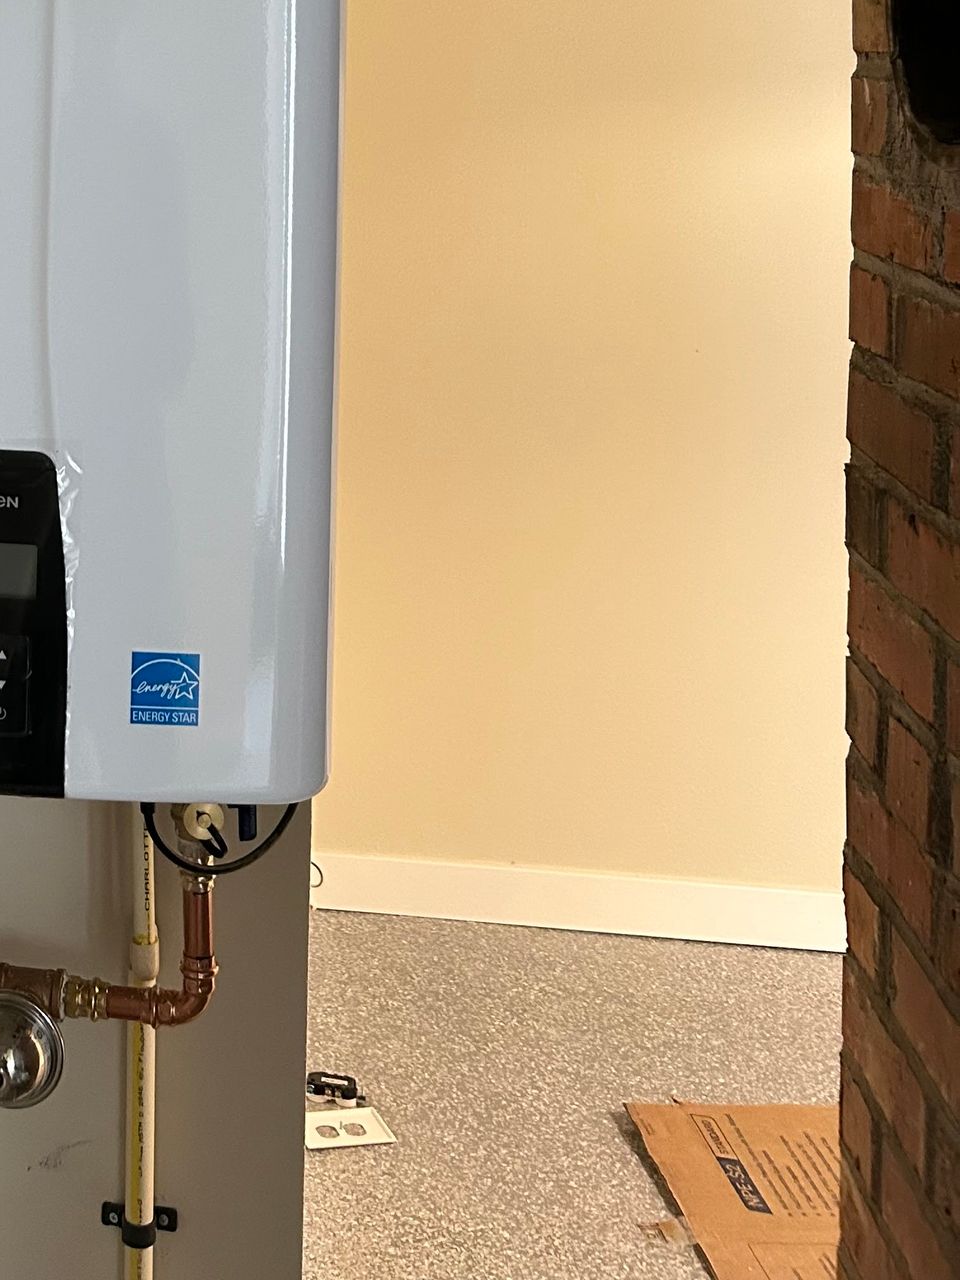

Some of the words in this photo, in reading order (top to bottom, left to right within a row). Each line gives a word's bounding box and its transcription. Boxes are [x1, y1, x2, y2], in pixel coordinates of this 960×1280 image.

[132, 680, 180, 700] energy
[132, 710, 171, 723] ENERGY
[171, 711, 197, 724] STAR
